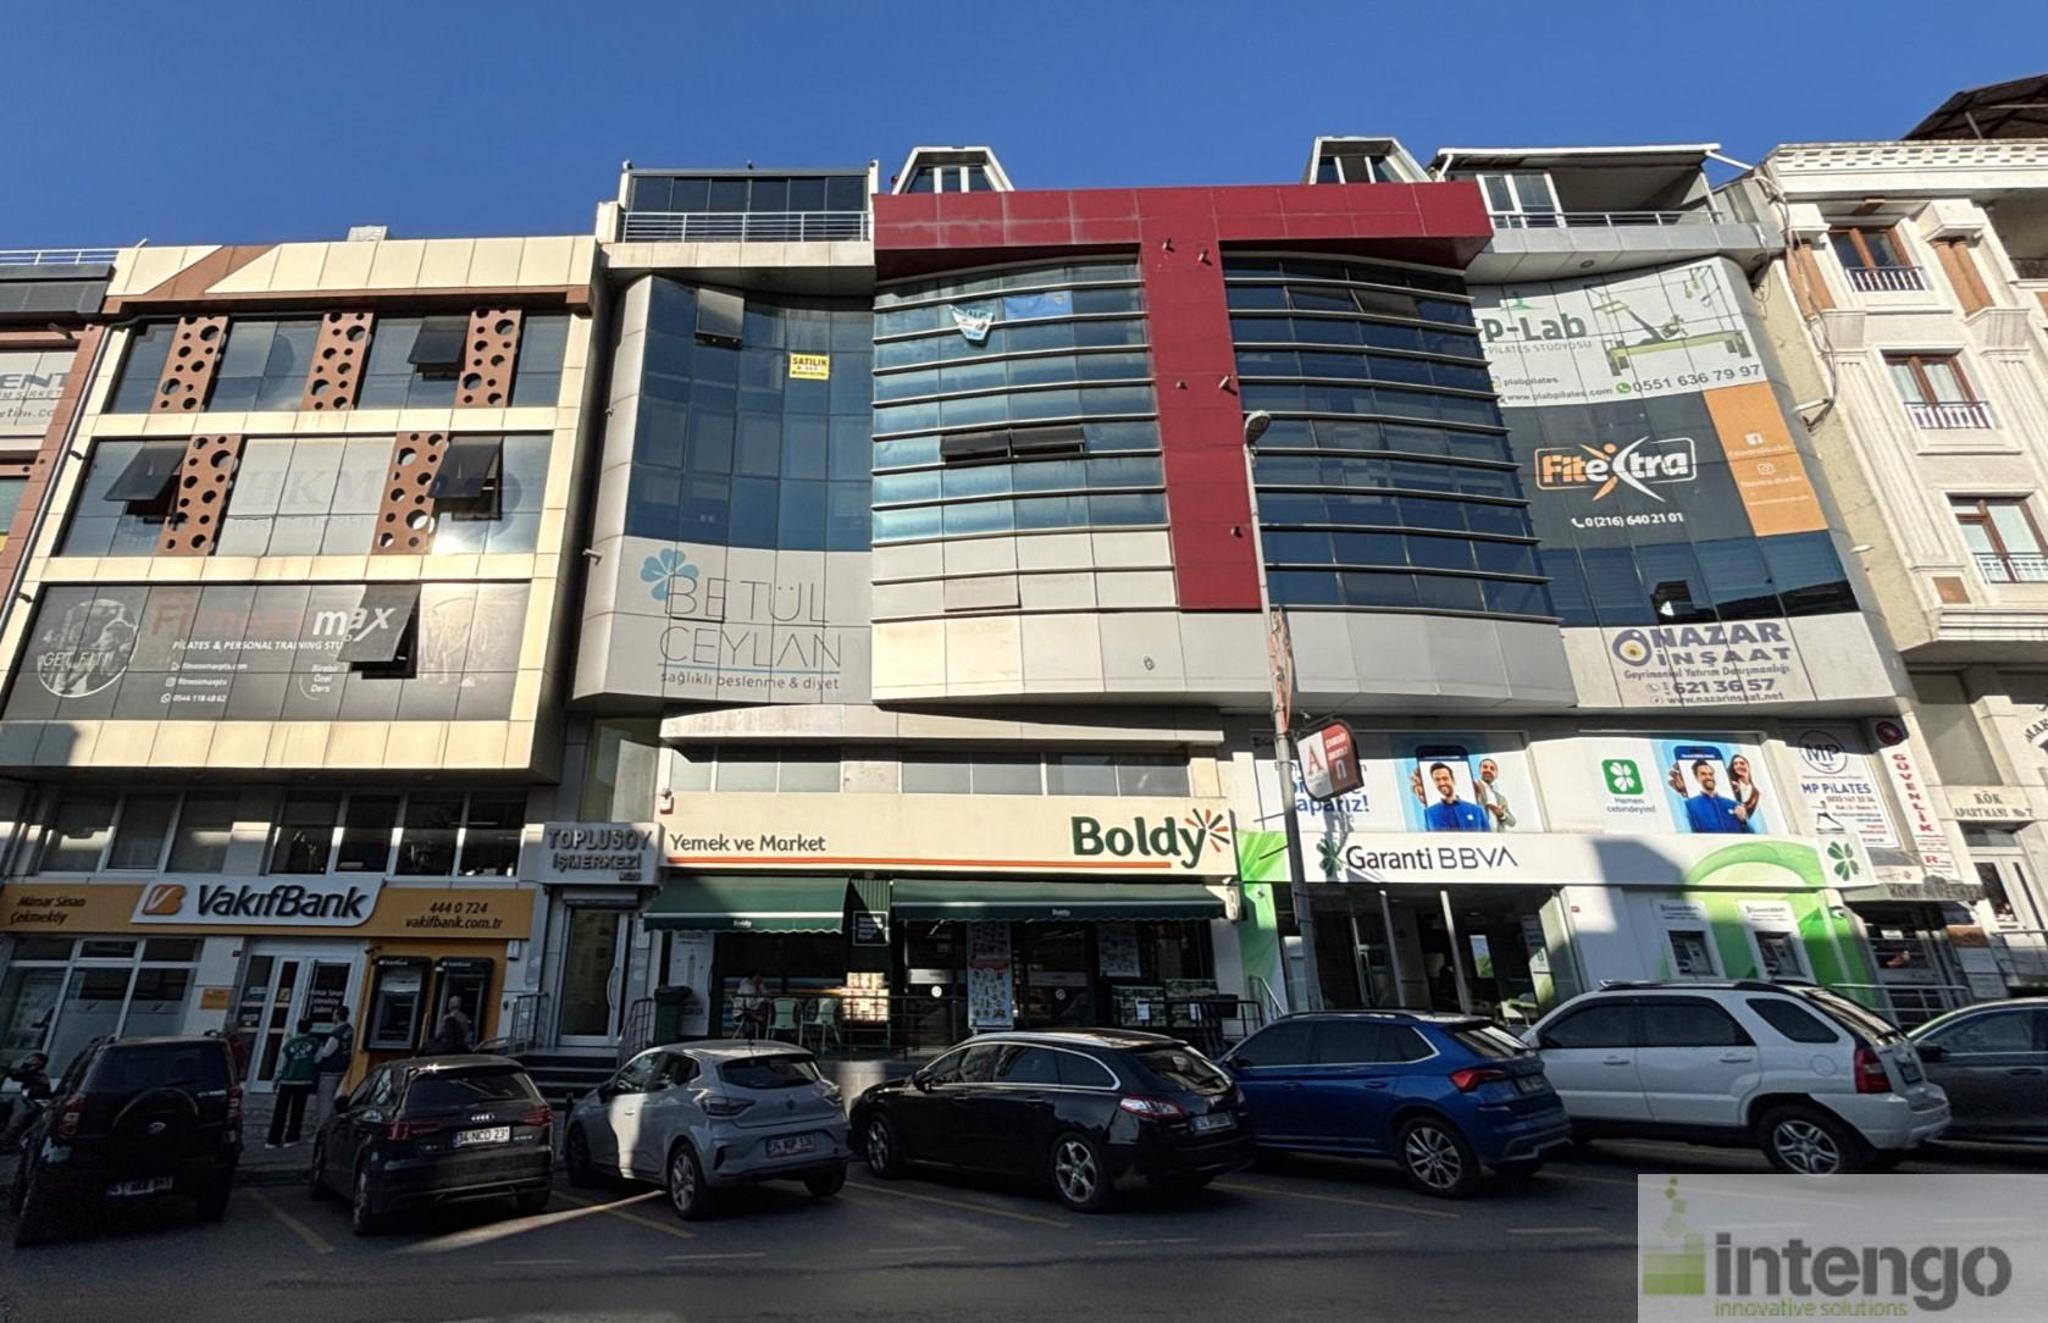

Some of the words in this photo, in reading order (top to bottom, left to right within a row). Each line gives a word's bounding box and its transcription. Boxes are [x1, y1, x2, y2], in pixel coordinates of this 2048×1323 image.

[1632, 378, 1672, 393] 0551
[1679, 372, 1709, 387] 636
[1713, 368, 1735, 381] 79
[1740, 364, 1761, 377] 97
[1626, 514, 1650, 526] 640
[1652, 513, 1666, 524] 21
[1669, 512, 1684, 523] 01
[665, 573, 830, 622] BETÜL
[312, 608, 396, 642] max
[1651, 622, 1785, 648] NAZAR
[213, 639, 223, 652] &
[224, 639, 272, 651] PERSONAL
[275, 640, 322, 651] TRAINING
[660, 625, 841, 668] CEYLAN
[1657, 647, 1791, 667] İNŞAAT
[661, 671, 713, 687] sağlıklı
[788, 678, 799, 689] &
[803, 676, 839, 692] diyet
[1673, 681, 1710, 695] 621
[1713, 680, 1743, 693] 36
[1746, 678, 1776, 692] 57
[1802, 783, 1820, 794] MP
[1892, 753, 1935, 832] GÜVENLİK
[1974, 791, 2003, 804] KÖK
[548, 829, 653, 851] TOPLUSOY
[670, 833, 730, 851] Yemek
[734, 838, 755, 851] ve
[759, 834, 827, 852] Market
[1071, 816, 1207, 869] Boldy
[1345, 845, 1434, 870] Garanti
[1437, 846, 1519, 869] BBVA
[198, 885, 369, 918] VakıfBank
[430, 902, 453, 914] 444
[454, 902, 463, 914] 0
[465, 902, 489, 914] 724
